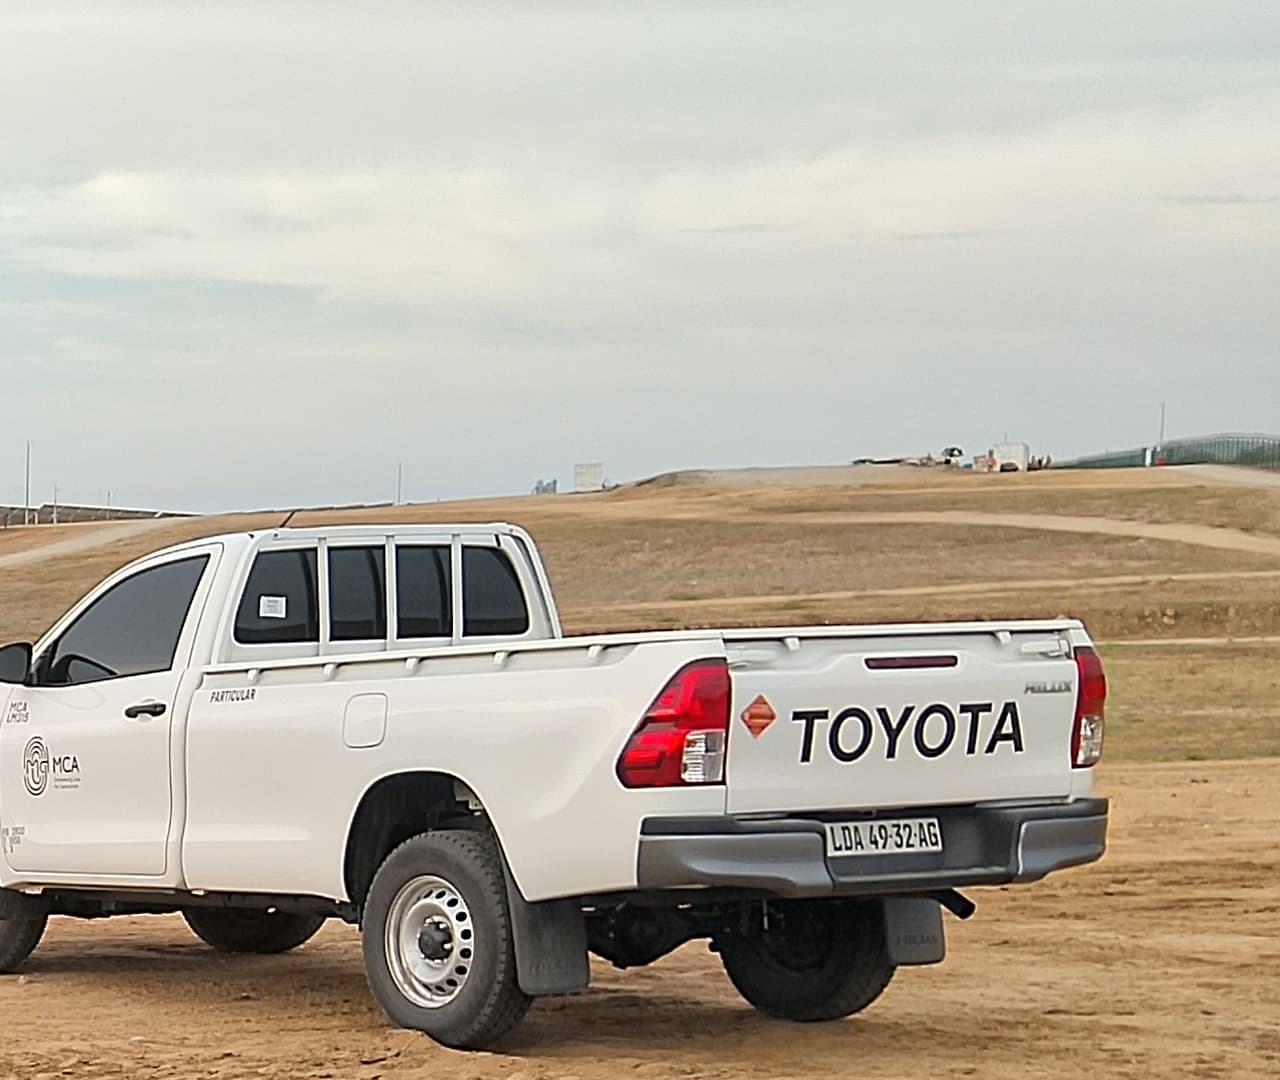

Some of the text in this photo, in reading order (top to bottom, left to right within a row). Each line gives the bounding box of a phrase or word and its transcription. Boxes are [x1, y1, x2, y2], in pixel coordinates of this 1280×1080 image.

[209, 688, 256, 703] PARTICULAR
[9, 702, 28, 712] MCA
[791, 702, 1024, 763] TOYOTA
[52, 755, 80, 774] MCA
[830, 825, 865, 851] LDA
